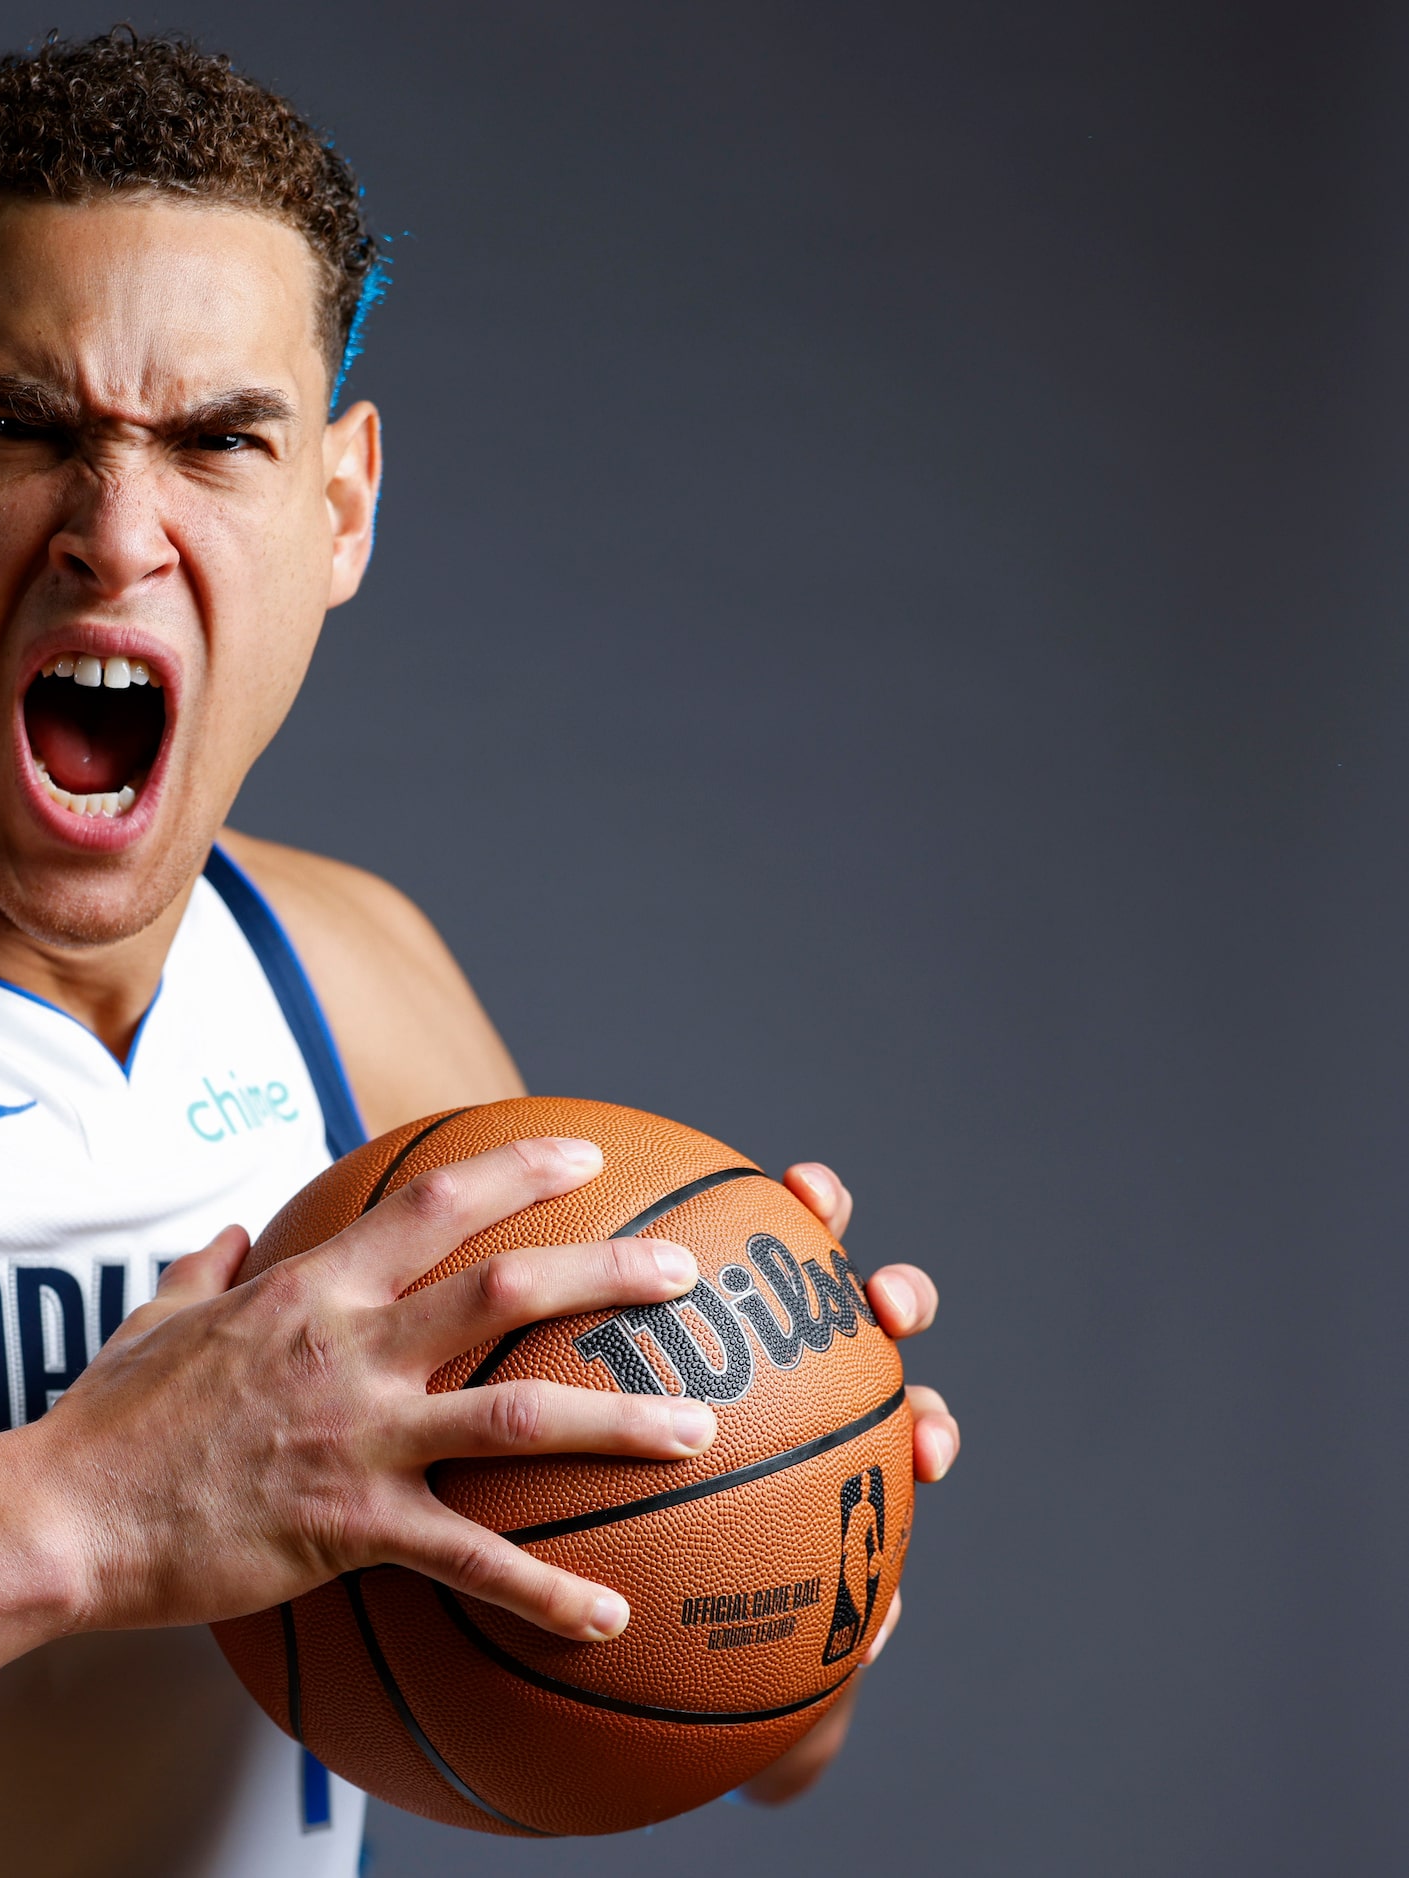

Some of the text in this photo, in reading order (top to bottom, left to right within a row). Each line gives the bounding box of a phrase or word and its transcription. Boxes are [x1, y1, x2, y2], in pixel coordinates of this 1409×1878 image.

[681, 1576, 821, 1626] OFFICIAL GAME BALL
[707, 1616, 796, 1650] GENUINE LEATHER
